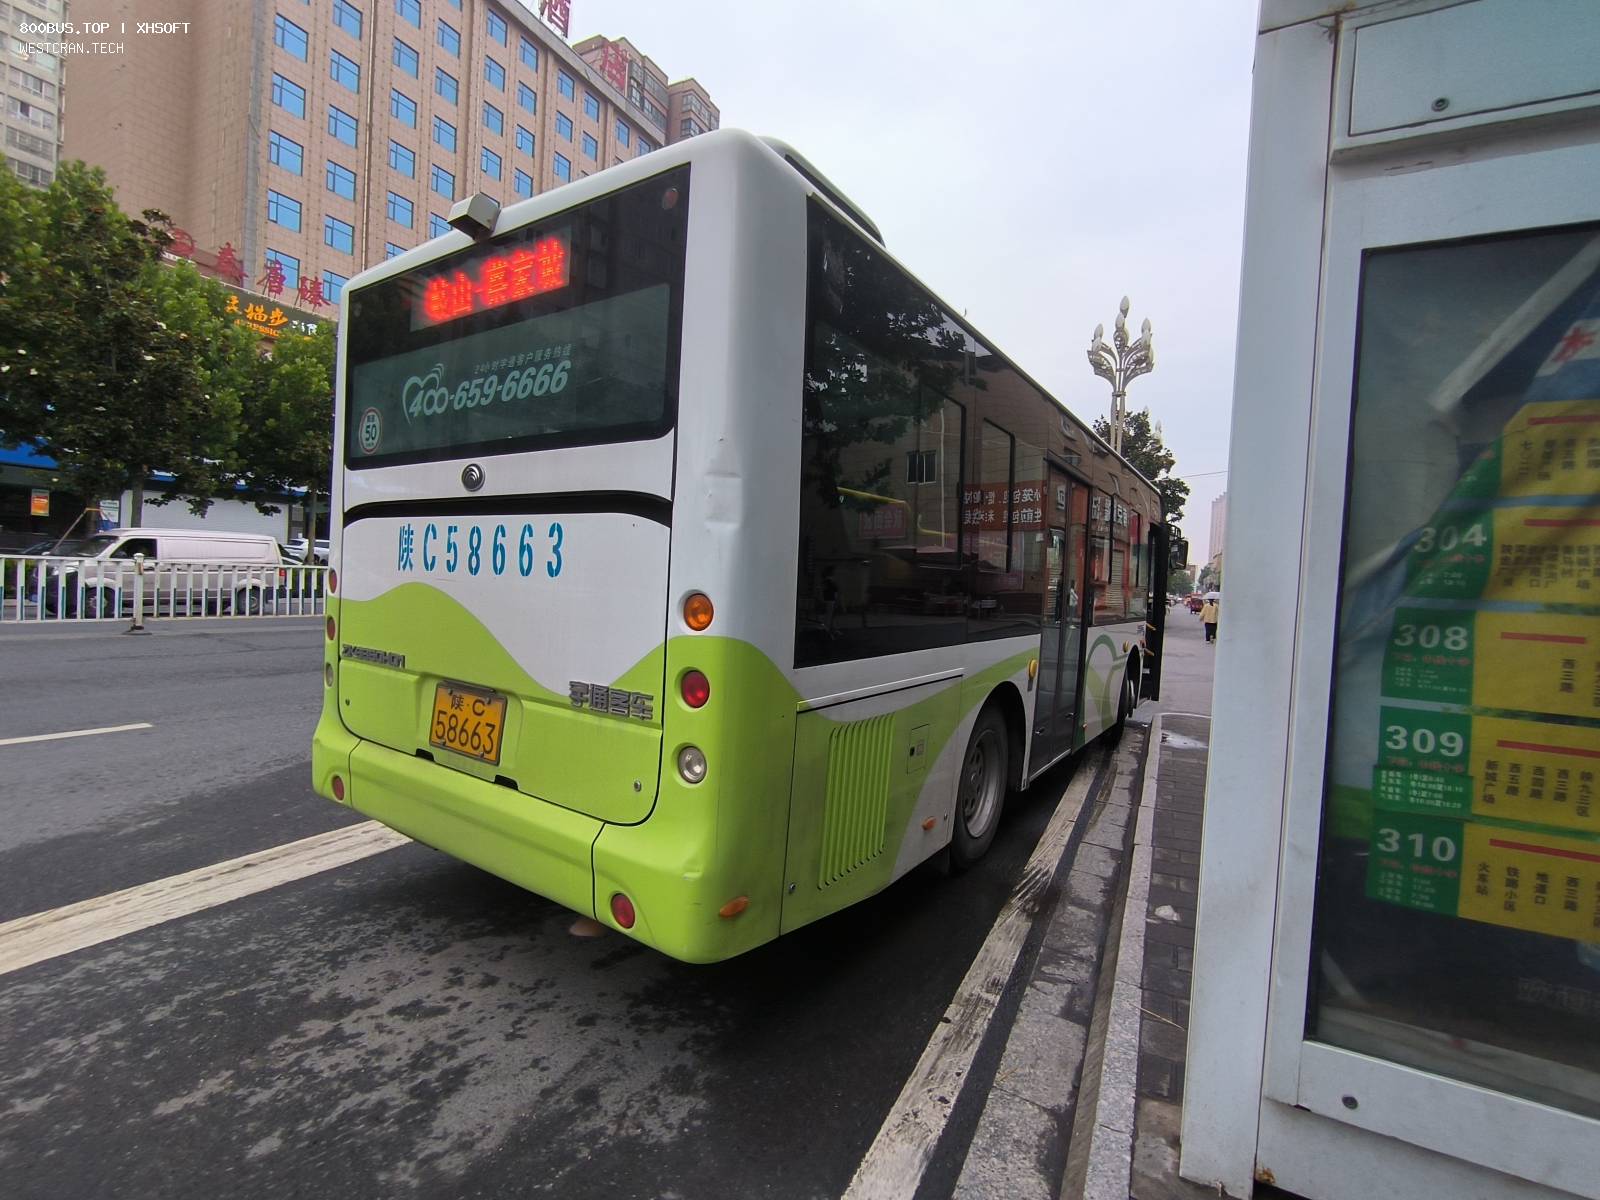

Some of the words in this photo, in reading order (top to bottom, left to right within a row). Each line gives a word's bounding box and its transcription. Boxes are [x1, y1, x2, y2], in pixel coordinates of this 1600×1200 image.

[408, 360, 571, 417] 400-659-6666
[365, 424, 377, 441] 50
[397, 522, 563, 577] 陕C58663
[1413, 523, 1488, 552] 304
[1393, 623, 1469, 651] 308
[435, 710, 496, 754] 58663
[1385, 724, 1464, 757] 309
[1376, 827, 1456, 862] 310
